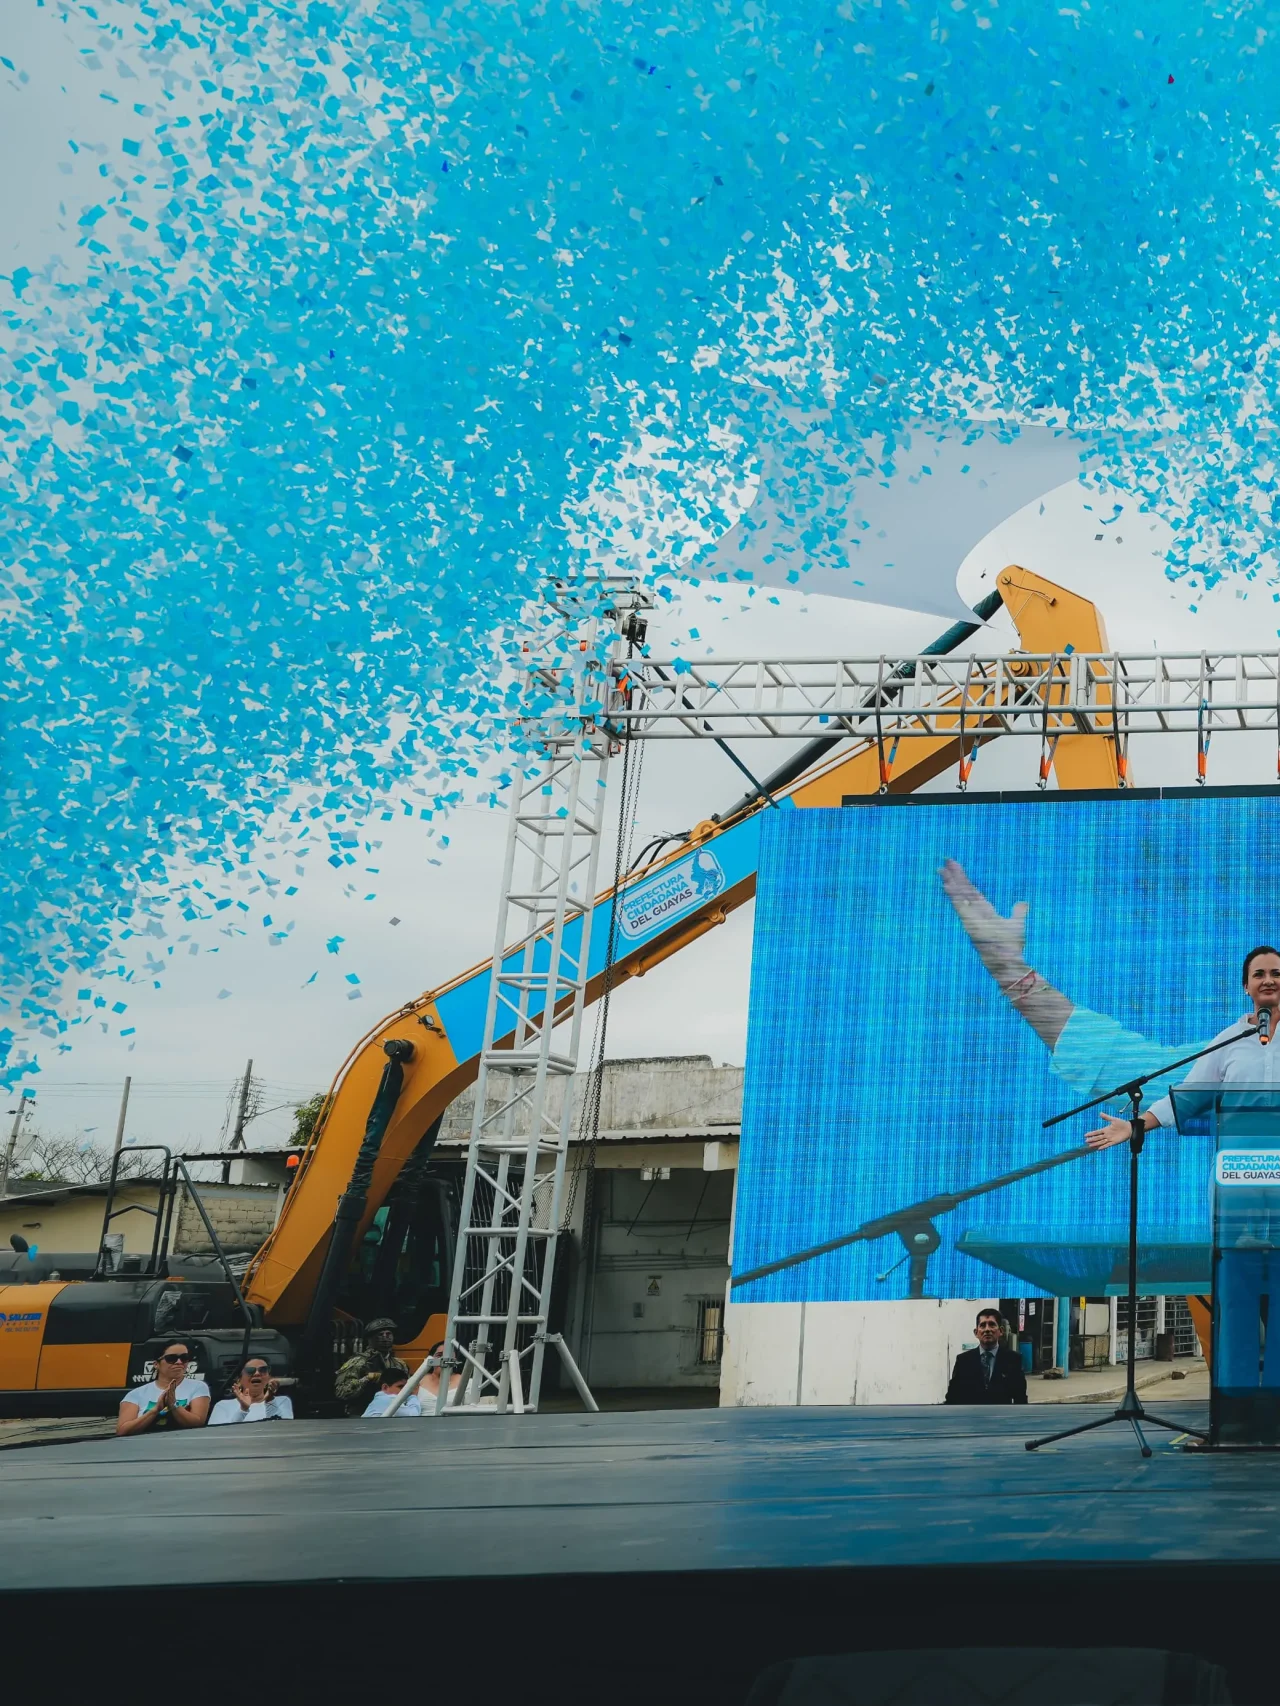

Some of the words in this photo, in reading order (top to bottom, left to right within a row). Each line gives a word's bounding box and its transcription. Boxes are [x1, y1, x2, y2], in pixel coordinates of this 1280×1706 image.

[623, 873, 684, 913] PREFECTURA
[626, 881, 689, 920] CIUDADANA
[630, 915, 652, 930] DEL
[652, 888, 693, 917] GUAYAS
[1222, 1155, 1280, 1163] PREFECTURA
[1222, 1163, 1280, 1171] CIUDADANA
[1222, 1171, 1241, 1179] DEL
